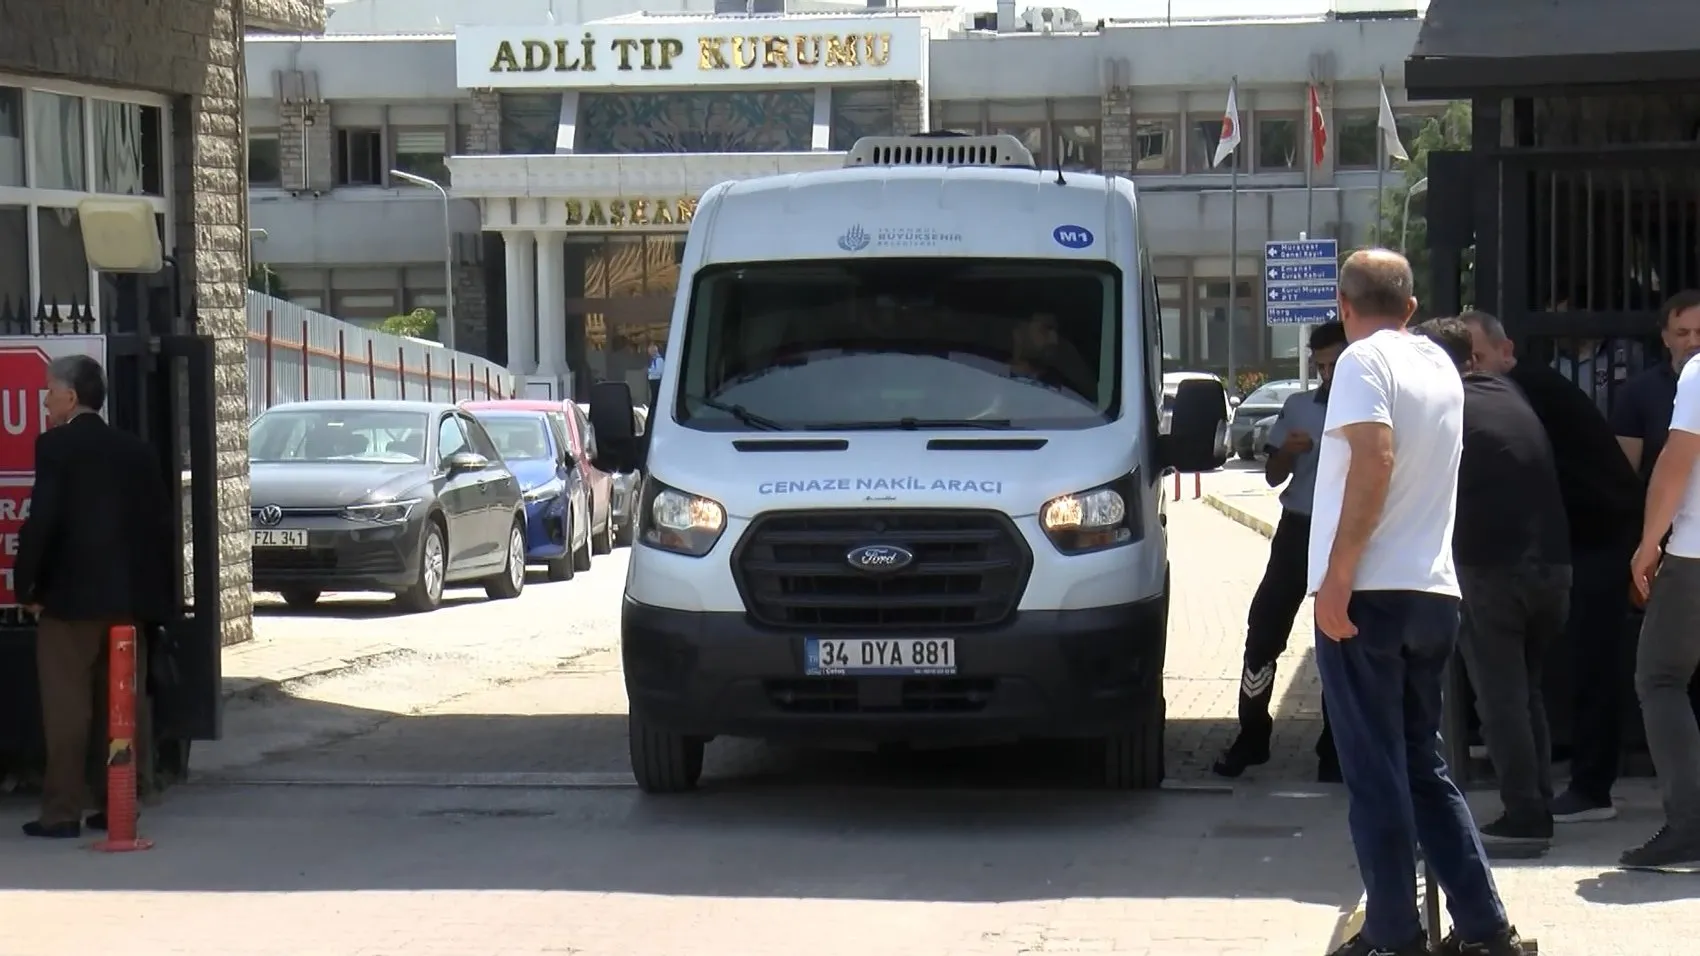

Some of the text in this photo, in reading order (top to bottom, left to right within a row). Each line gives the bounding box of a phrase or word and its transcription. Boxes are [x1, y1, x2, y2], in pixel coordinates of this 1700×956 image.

[489, 31, 893, 72] ADLİ TIP KURUMU
[1060, 231, 1088, 242] M1
[758, 476, 1002, 495] CENAZE NAKİL ARACI
[254, 530, 303, 545] FZL 341
[861, 550, 897, 564] Ford
[822, 641, 949, 666] 34 DYA 881
